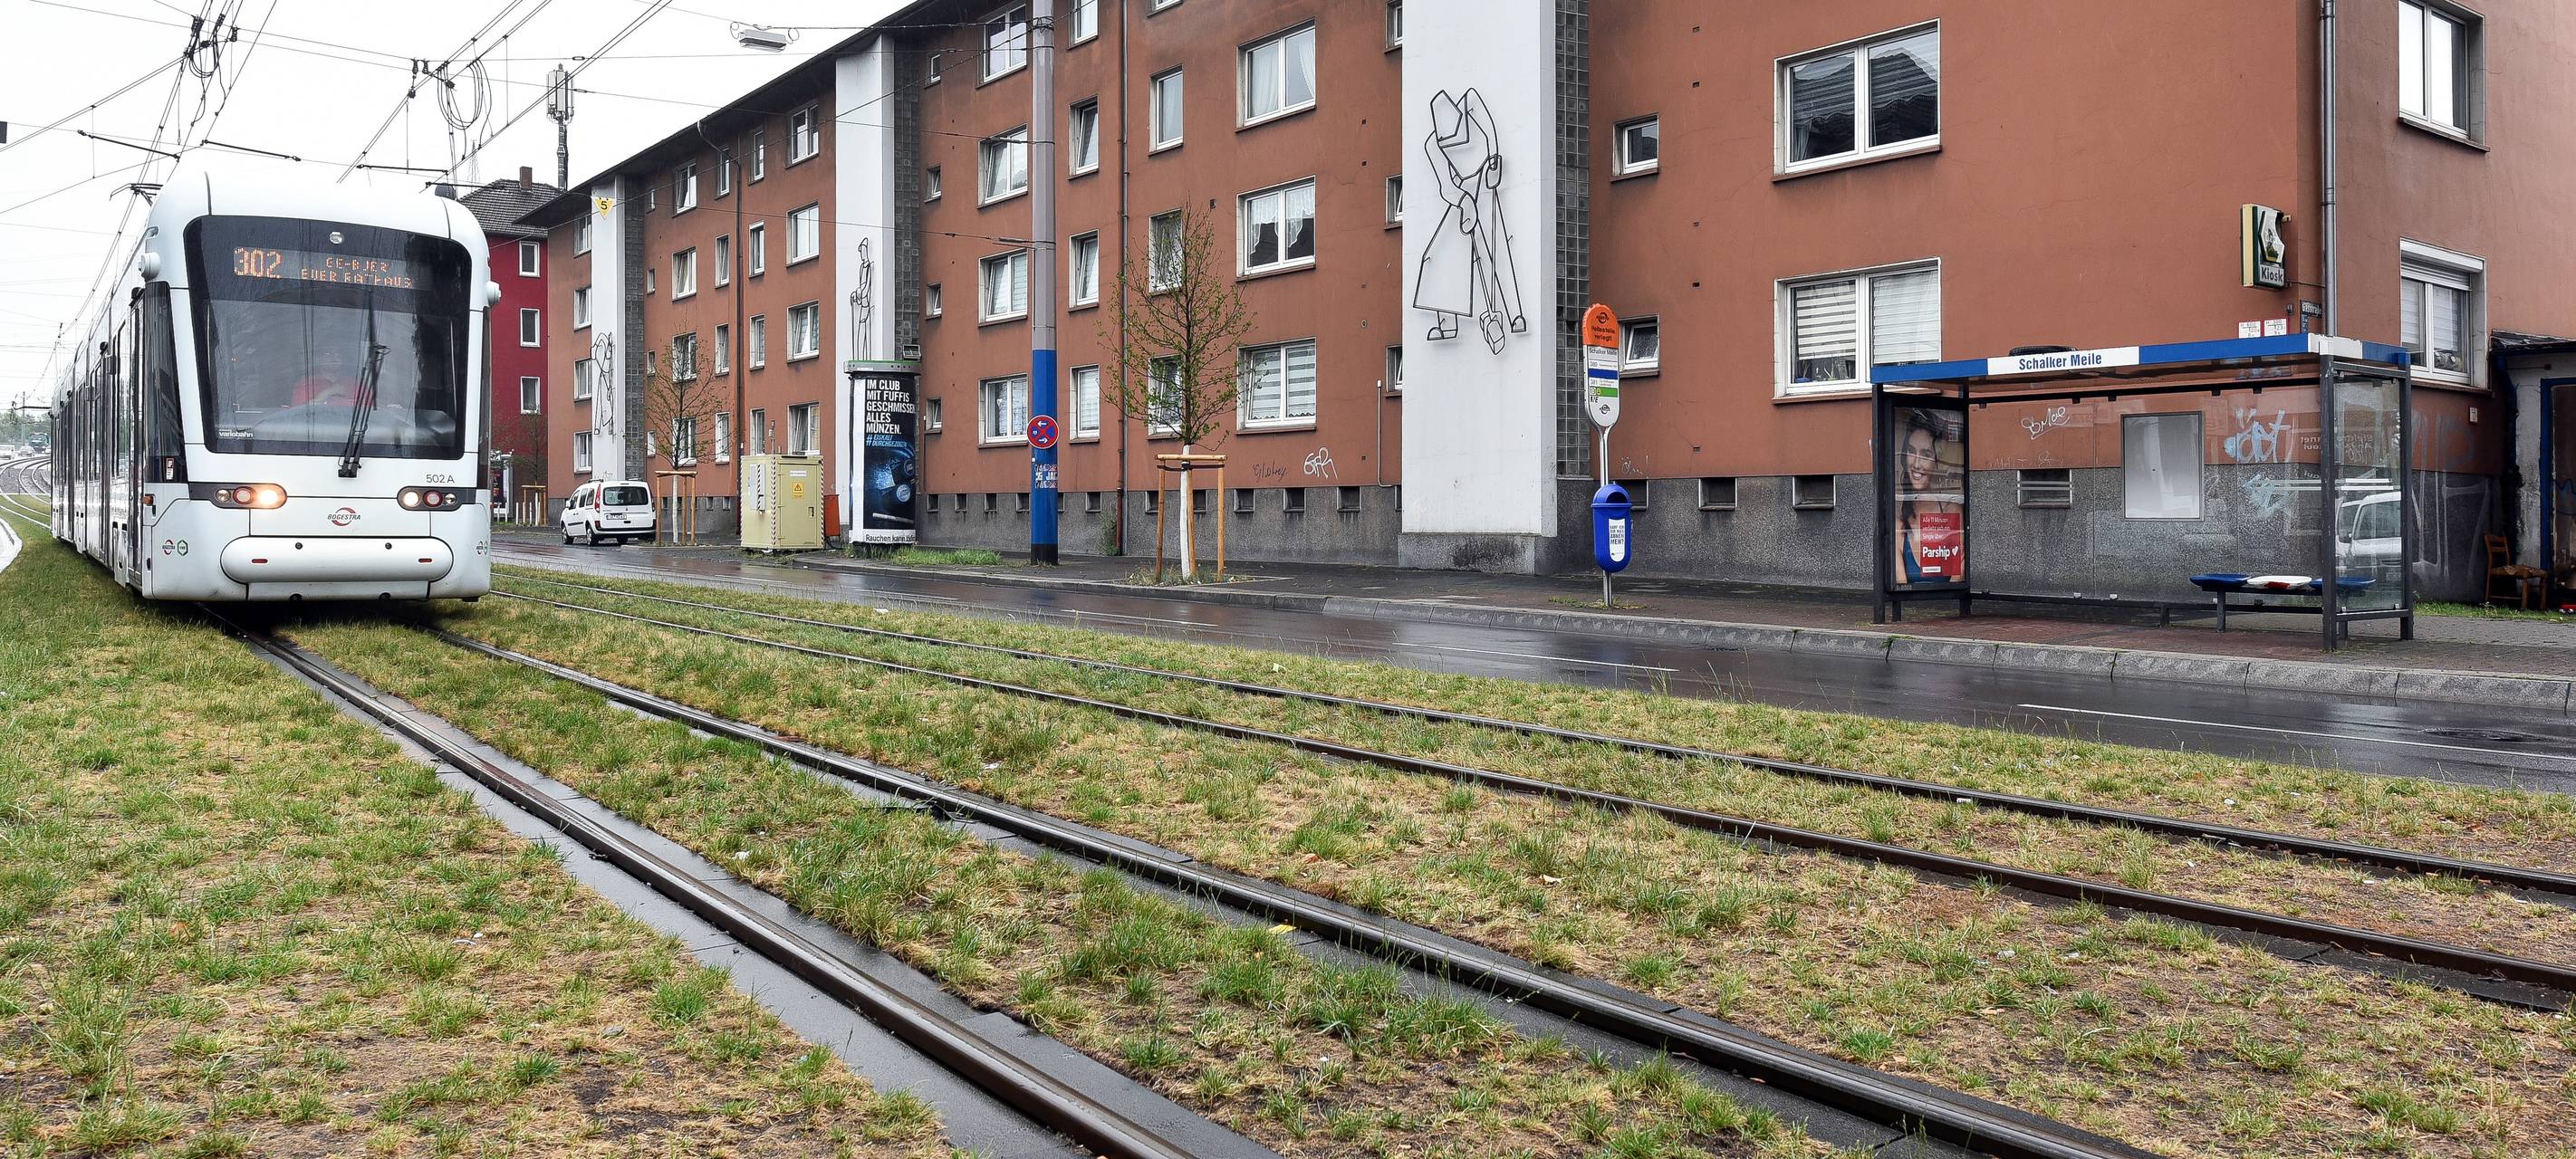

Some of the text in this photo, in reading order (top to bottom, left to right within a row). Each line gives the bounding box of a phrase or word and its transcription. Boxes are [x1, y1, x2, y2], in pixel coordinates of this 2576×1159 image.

[601, 200, 608, 210] 5
[234, 247, 282, 278] 302
[2261, 266, 2283, 283] Kiosk
[2019, 353, 2102, 369] Schalker Meile
[867, 378, 900, 391] IM CLUB
[867, 389, 910, 402] MIT FUFFIS
[866, 411, 891, 423] ALLES
[866, 420, 902, 435] MÜNZEN.
[426, 474, 455, 484] 502 A
[865, 533, 891, 542] Rauchen
[891, 533, 907, 542] kann
[1922, 545, 1951, 560] Parship
